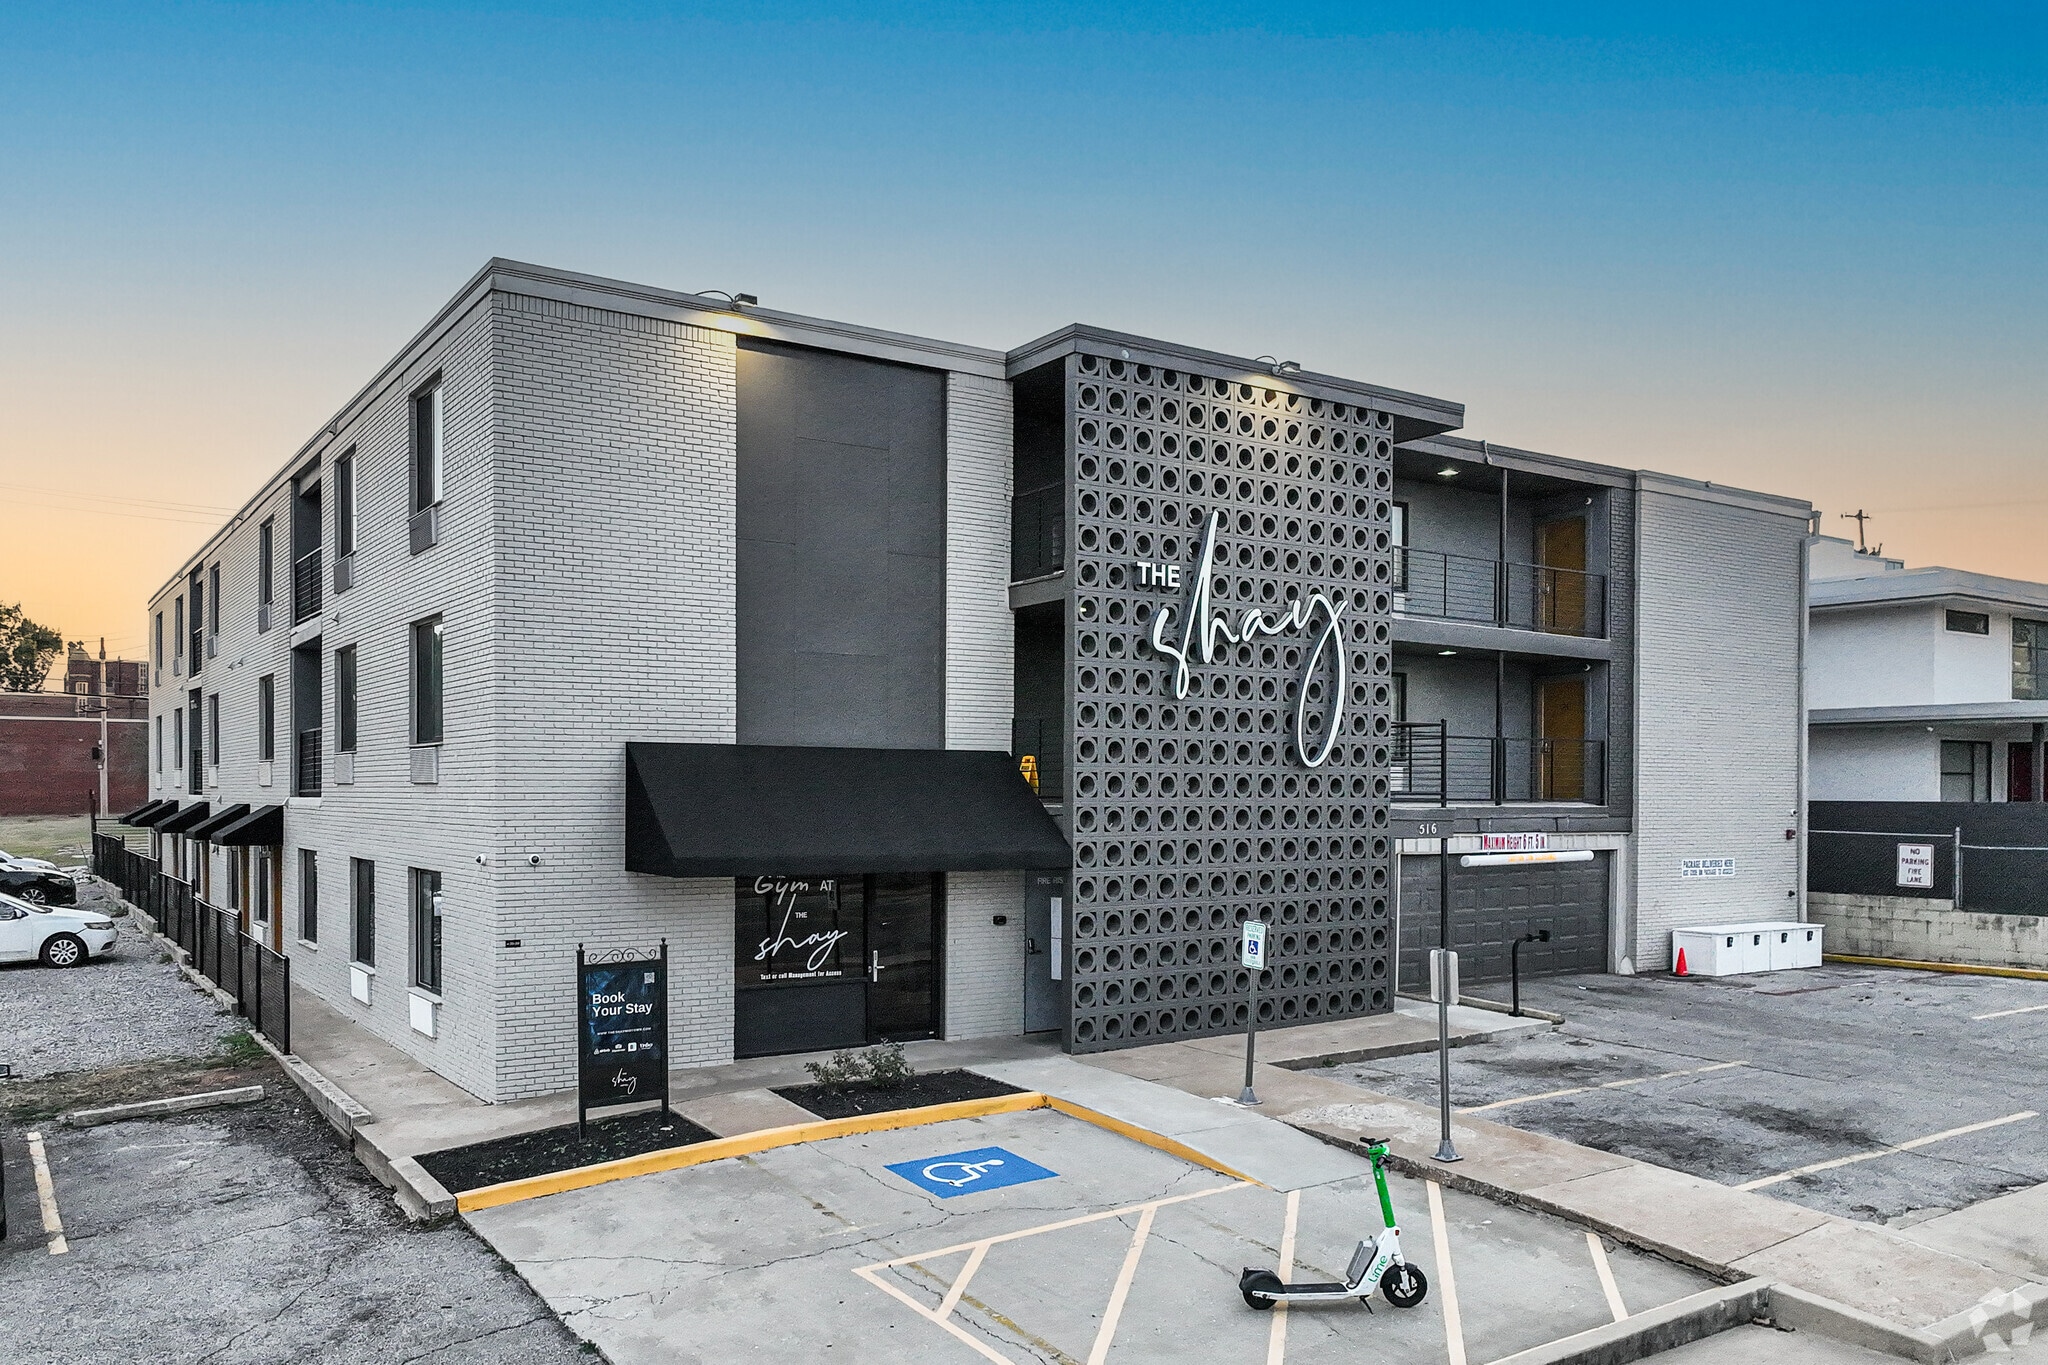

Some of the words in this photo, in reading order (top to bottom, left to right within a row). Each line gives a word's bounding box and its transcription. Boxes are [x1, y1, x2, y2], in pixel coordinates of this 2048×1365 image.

[1136, 561, 1181, 588] THE
[1153, 510, 1349, 768] shay
[1419, 823, 1437, 835] 516
[1523, 834, 1527, 850] 6
[1536, 833, 1540, 849] 5
[755, 876, 808, 905] Gym
[820, 880, 834, 891] AT
[754, 893, 848, 971] shay
[592, 991, 626, 1005] Book
[592, 1005, 622, 1017] Your
[625, 1002, 653, 1016] Stay
[1368, 1255, 1387, 1283] Lime
